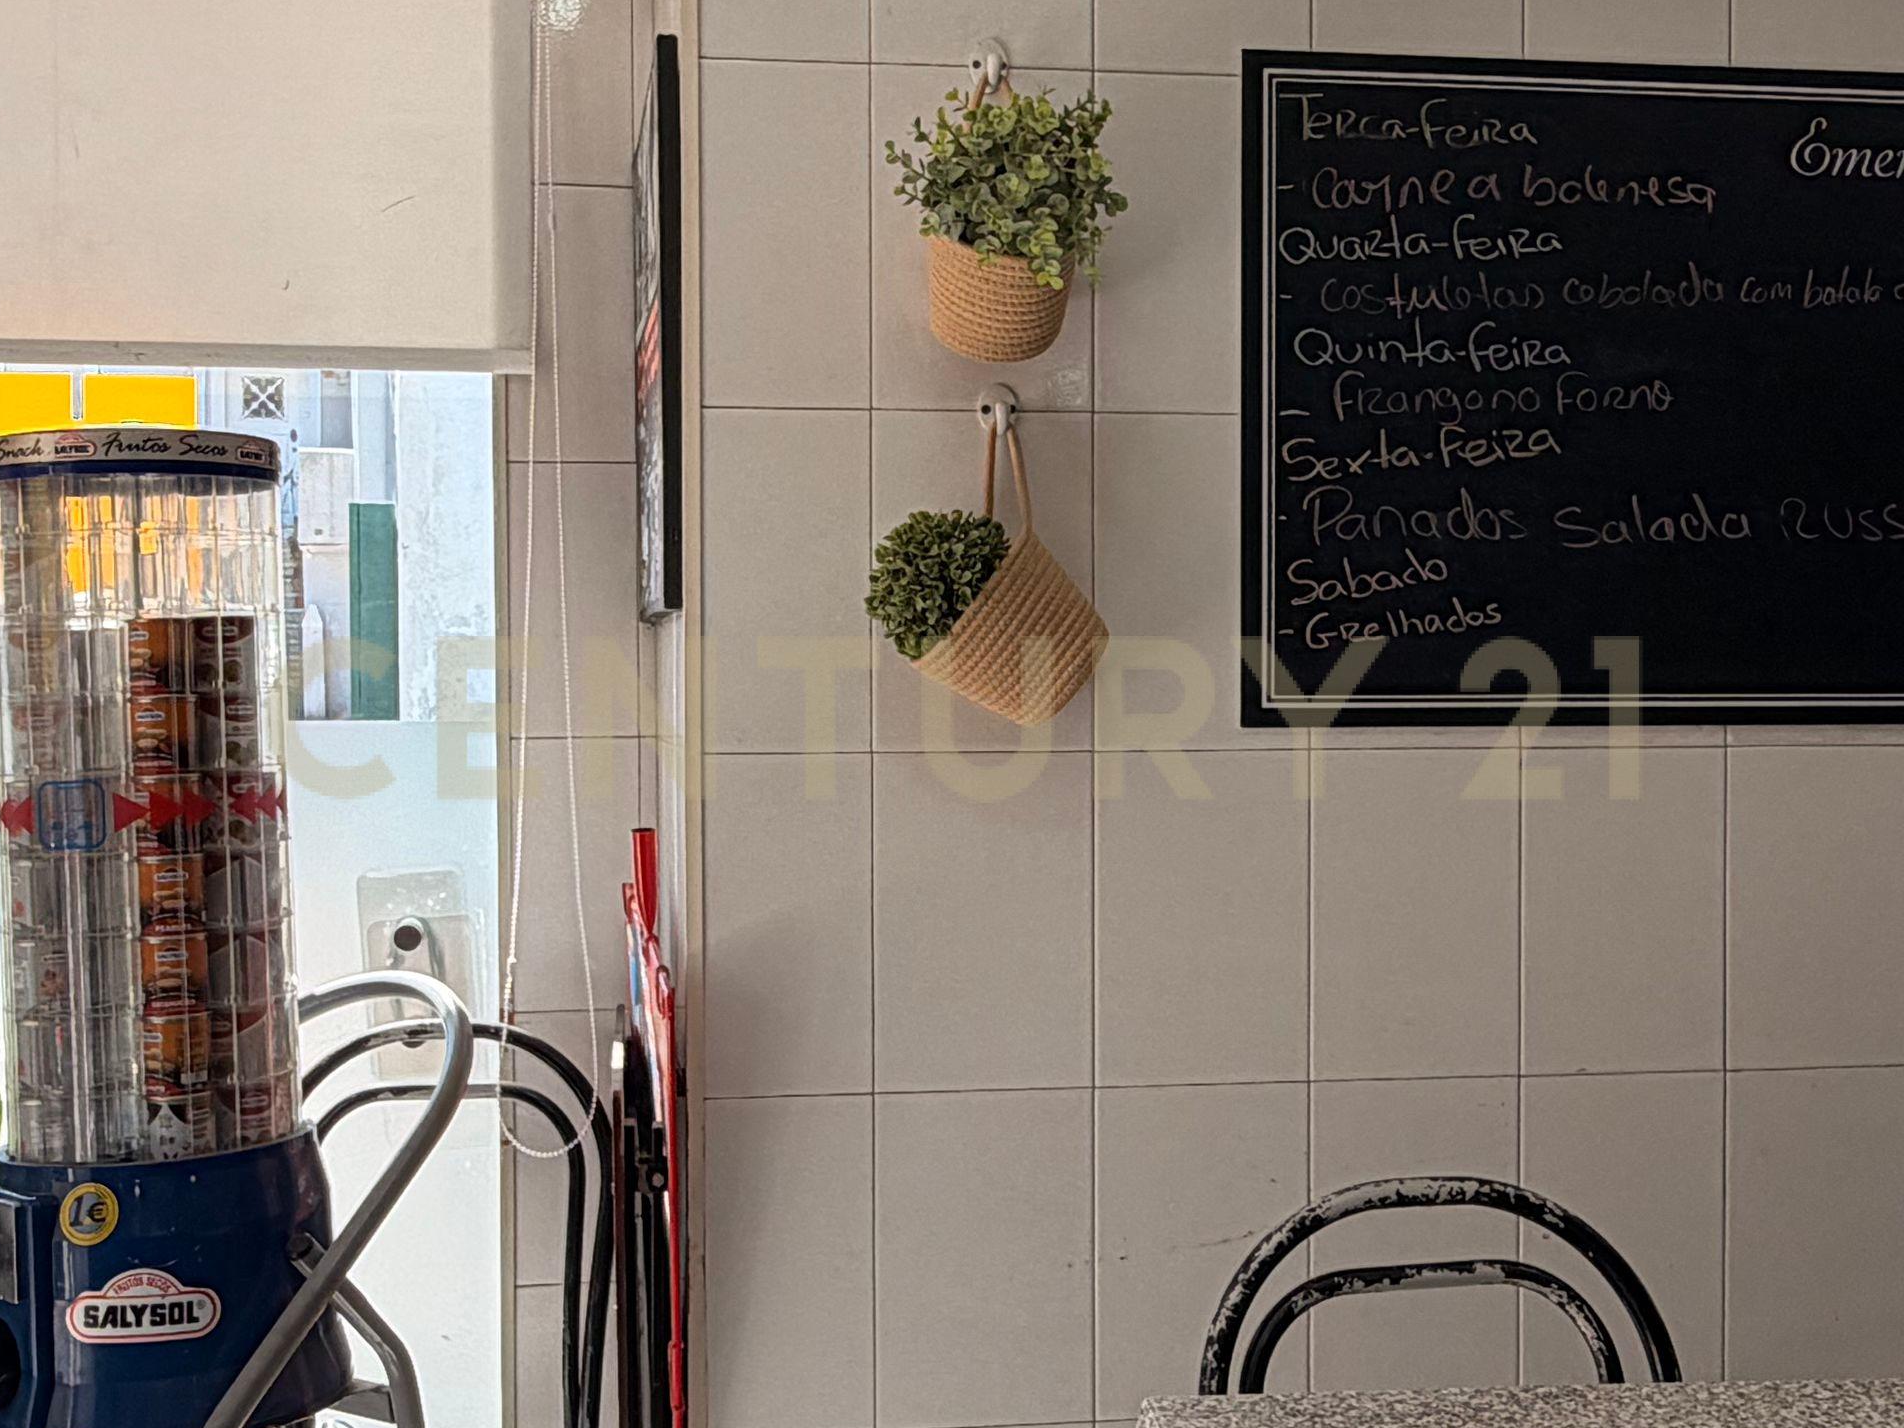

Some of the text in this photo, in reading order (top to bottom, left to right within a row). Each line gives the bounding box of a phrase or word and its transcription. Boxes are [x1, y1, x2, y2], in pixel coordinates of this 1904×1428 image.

[1311, 166, 1457, 213] Carne
[102, 431, 172, 457] Frutos
[179, 433, 229, 456] Secos
[1300, 483, 1530, 547] Panados
[1552, 492, 1753, 549] Salada
[1285, 546, 1449, 607] Sabado
[1303, 595, 1505, 651] Grelhados
[83, 1300, 200, 1329] SALYSOL
